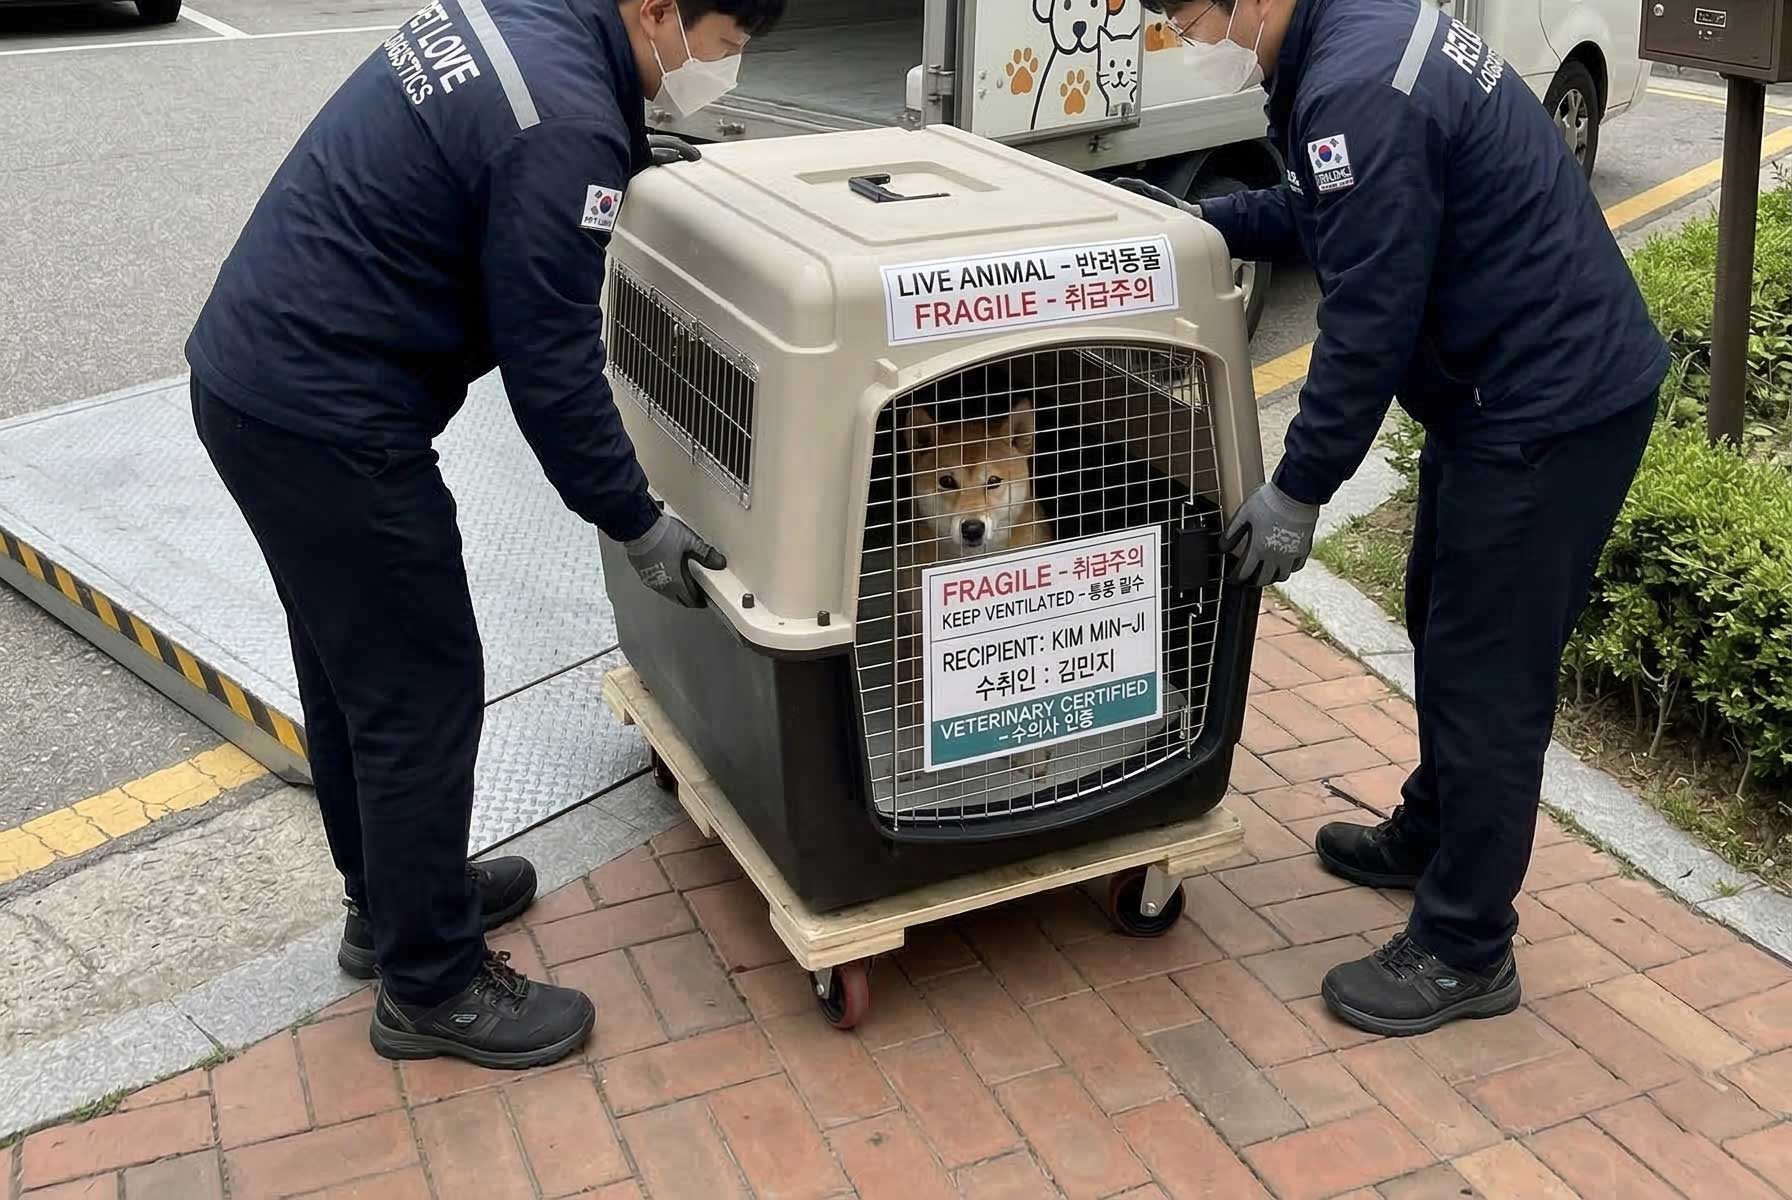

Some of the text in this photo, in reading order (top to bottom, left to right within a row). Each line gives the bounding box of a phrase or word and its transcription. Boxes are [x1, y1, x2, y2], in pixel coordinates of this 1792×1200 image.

[417, 22, 480, 94] LOVE
[898, 270, 952, 297] LIVE
[960, 258, 1055, 289] ANIMAL
[1076, 245, 1160, 278] 반려동물
[914, 291, 1037, 329] FRAGILE
[1065, 276, 1154, 311] 취급주의
[943, 564, 1051, 605] FRAGILE
[1072, 544, 1144, 580] 취급주의
[942, 608, 981, 630] KEEP
[985, 590, 1074, 621] VENTILATED
[943, 612, 1145, 672] RECIPIENT: KIM MIN-JI
[976, 666, 1036, 701] 수취인
[1058, 648, 1115, 683] 김민지
[940, 679, 1148, 740] VETERINARY CERTIFIED
[1012, 717, 1060, 744] 수의사
[1064, 708, 1094, 731] 인증
